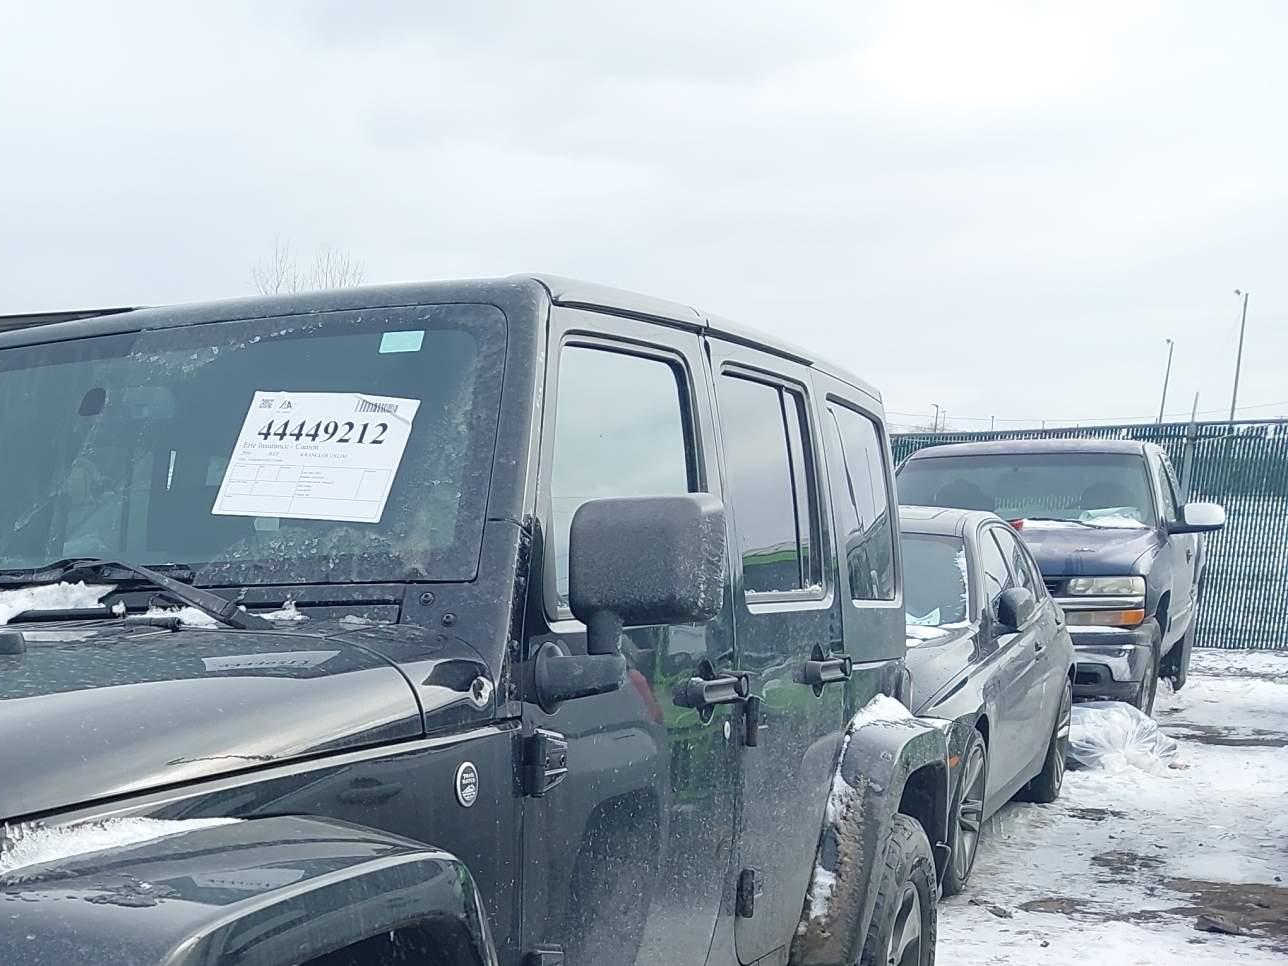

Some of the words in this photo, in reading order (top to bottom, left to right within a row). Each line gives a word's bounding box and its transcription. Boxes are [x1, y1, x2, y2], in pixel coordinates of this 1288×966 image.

[257, 419, 389, 445] 44449212
[243, 441, 257, 450] Erie
[258, 442, 290, 450] Insurance
